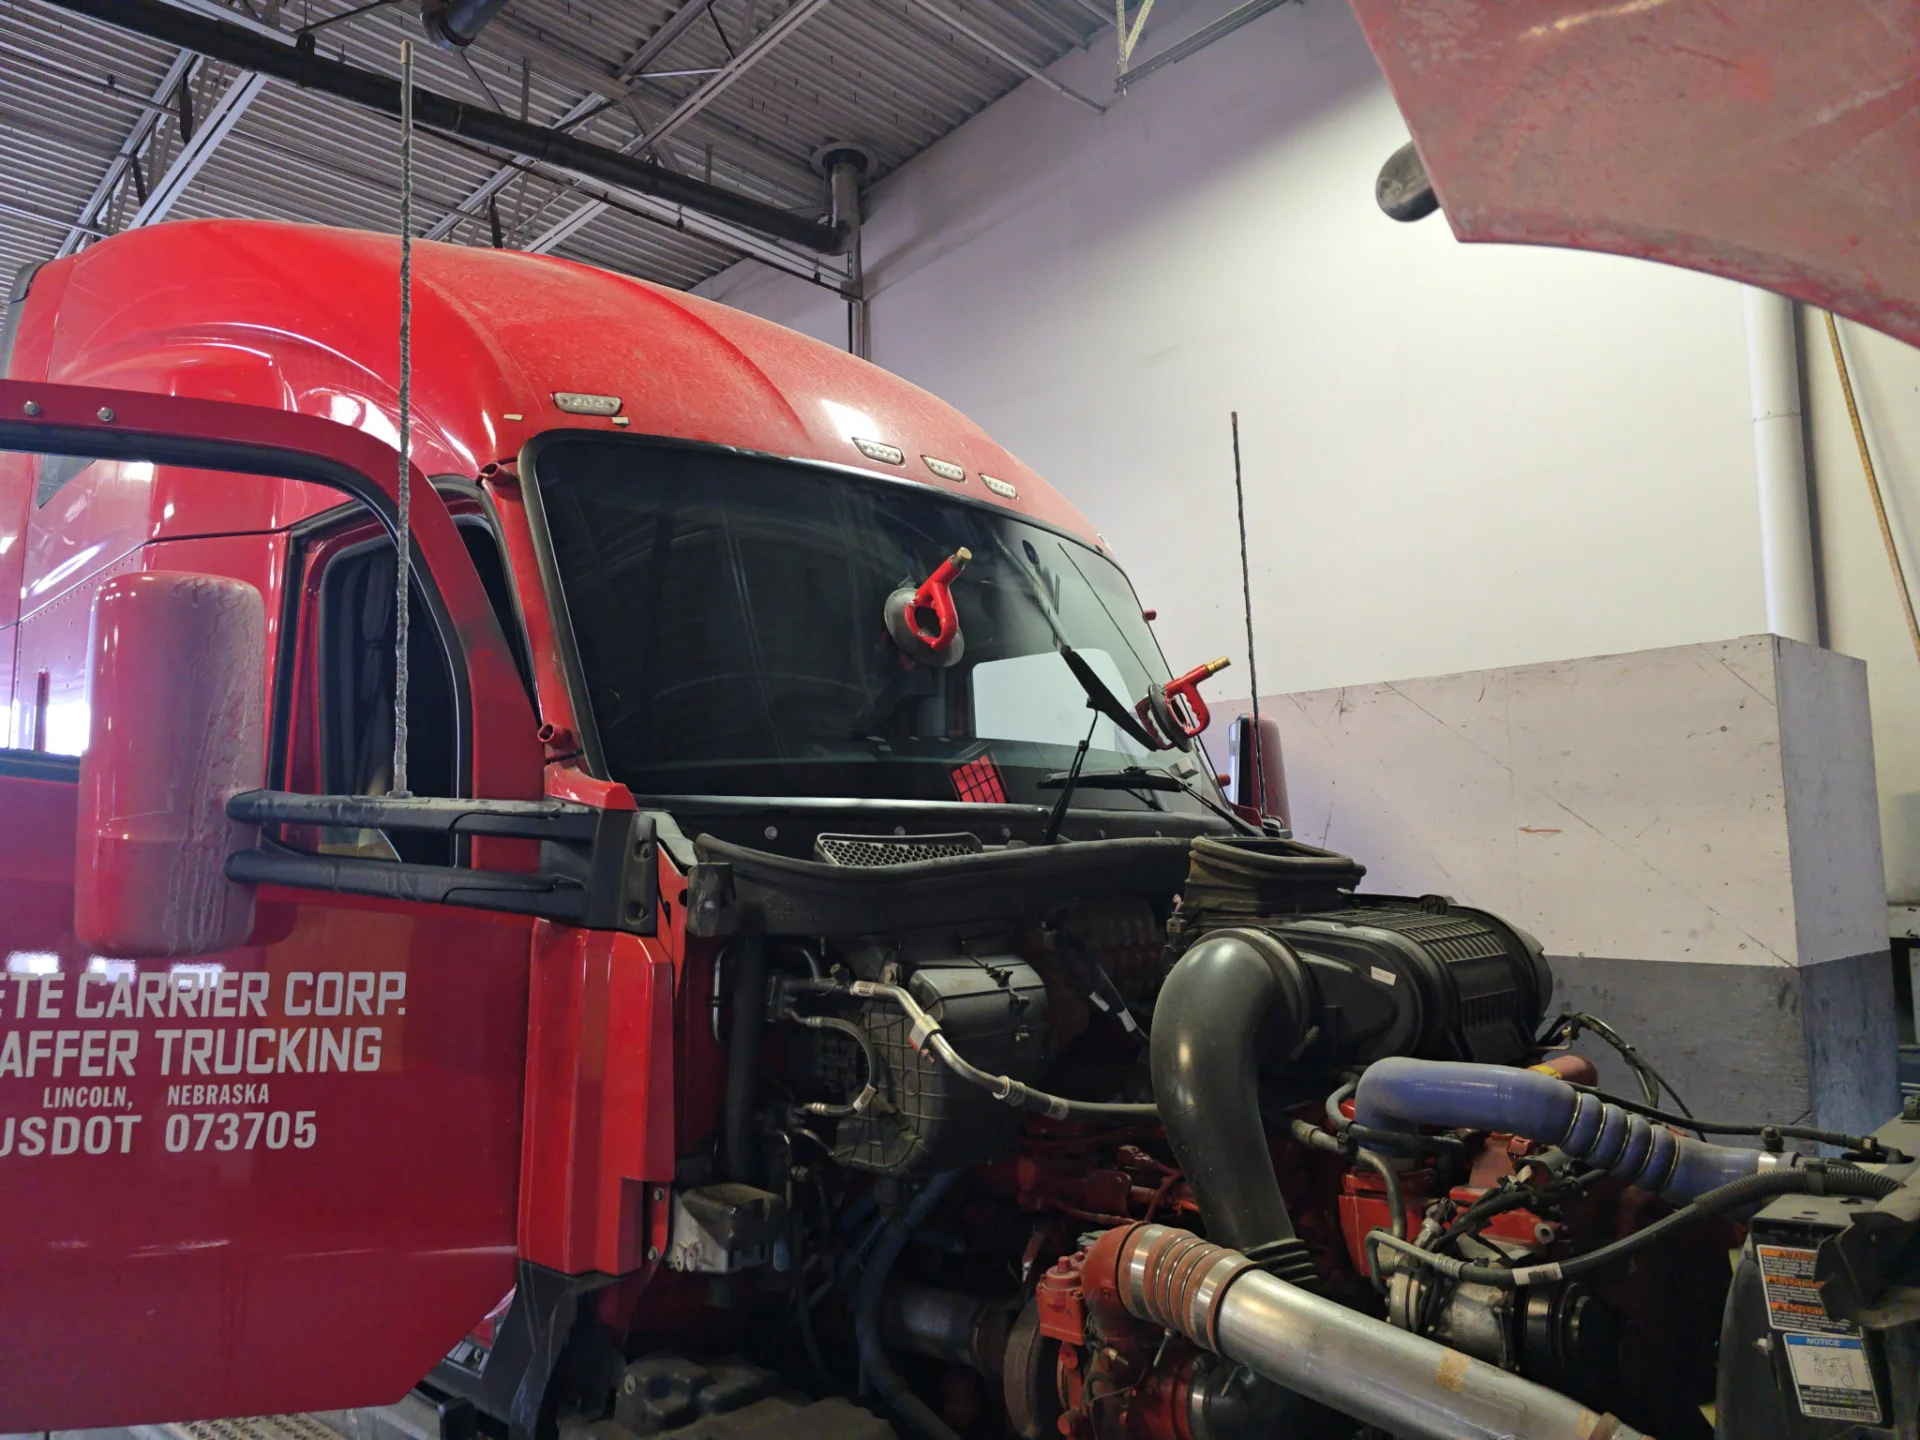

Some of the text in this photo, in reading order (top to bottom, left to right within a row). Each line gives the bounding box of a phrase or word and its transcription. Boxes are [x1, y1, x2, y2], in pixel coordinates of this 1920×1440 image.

[75, 971, 271, 1018] CARRIER
[284, 971, 407, 1017] CORP.
[0, 1027, 383, 1078] AFFER TRUCKING
[43, 1083, 270, 1111] LINCOLN, NEBRASKA
[164, 1110, 317, 1153] 073705
[1806, 1337, 1841, 1347] NOTICE
